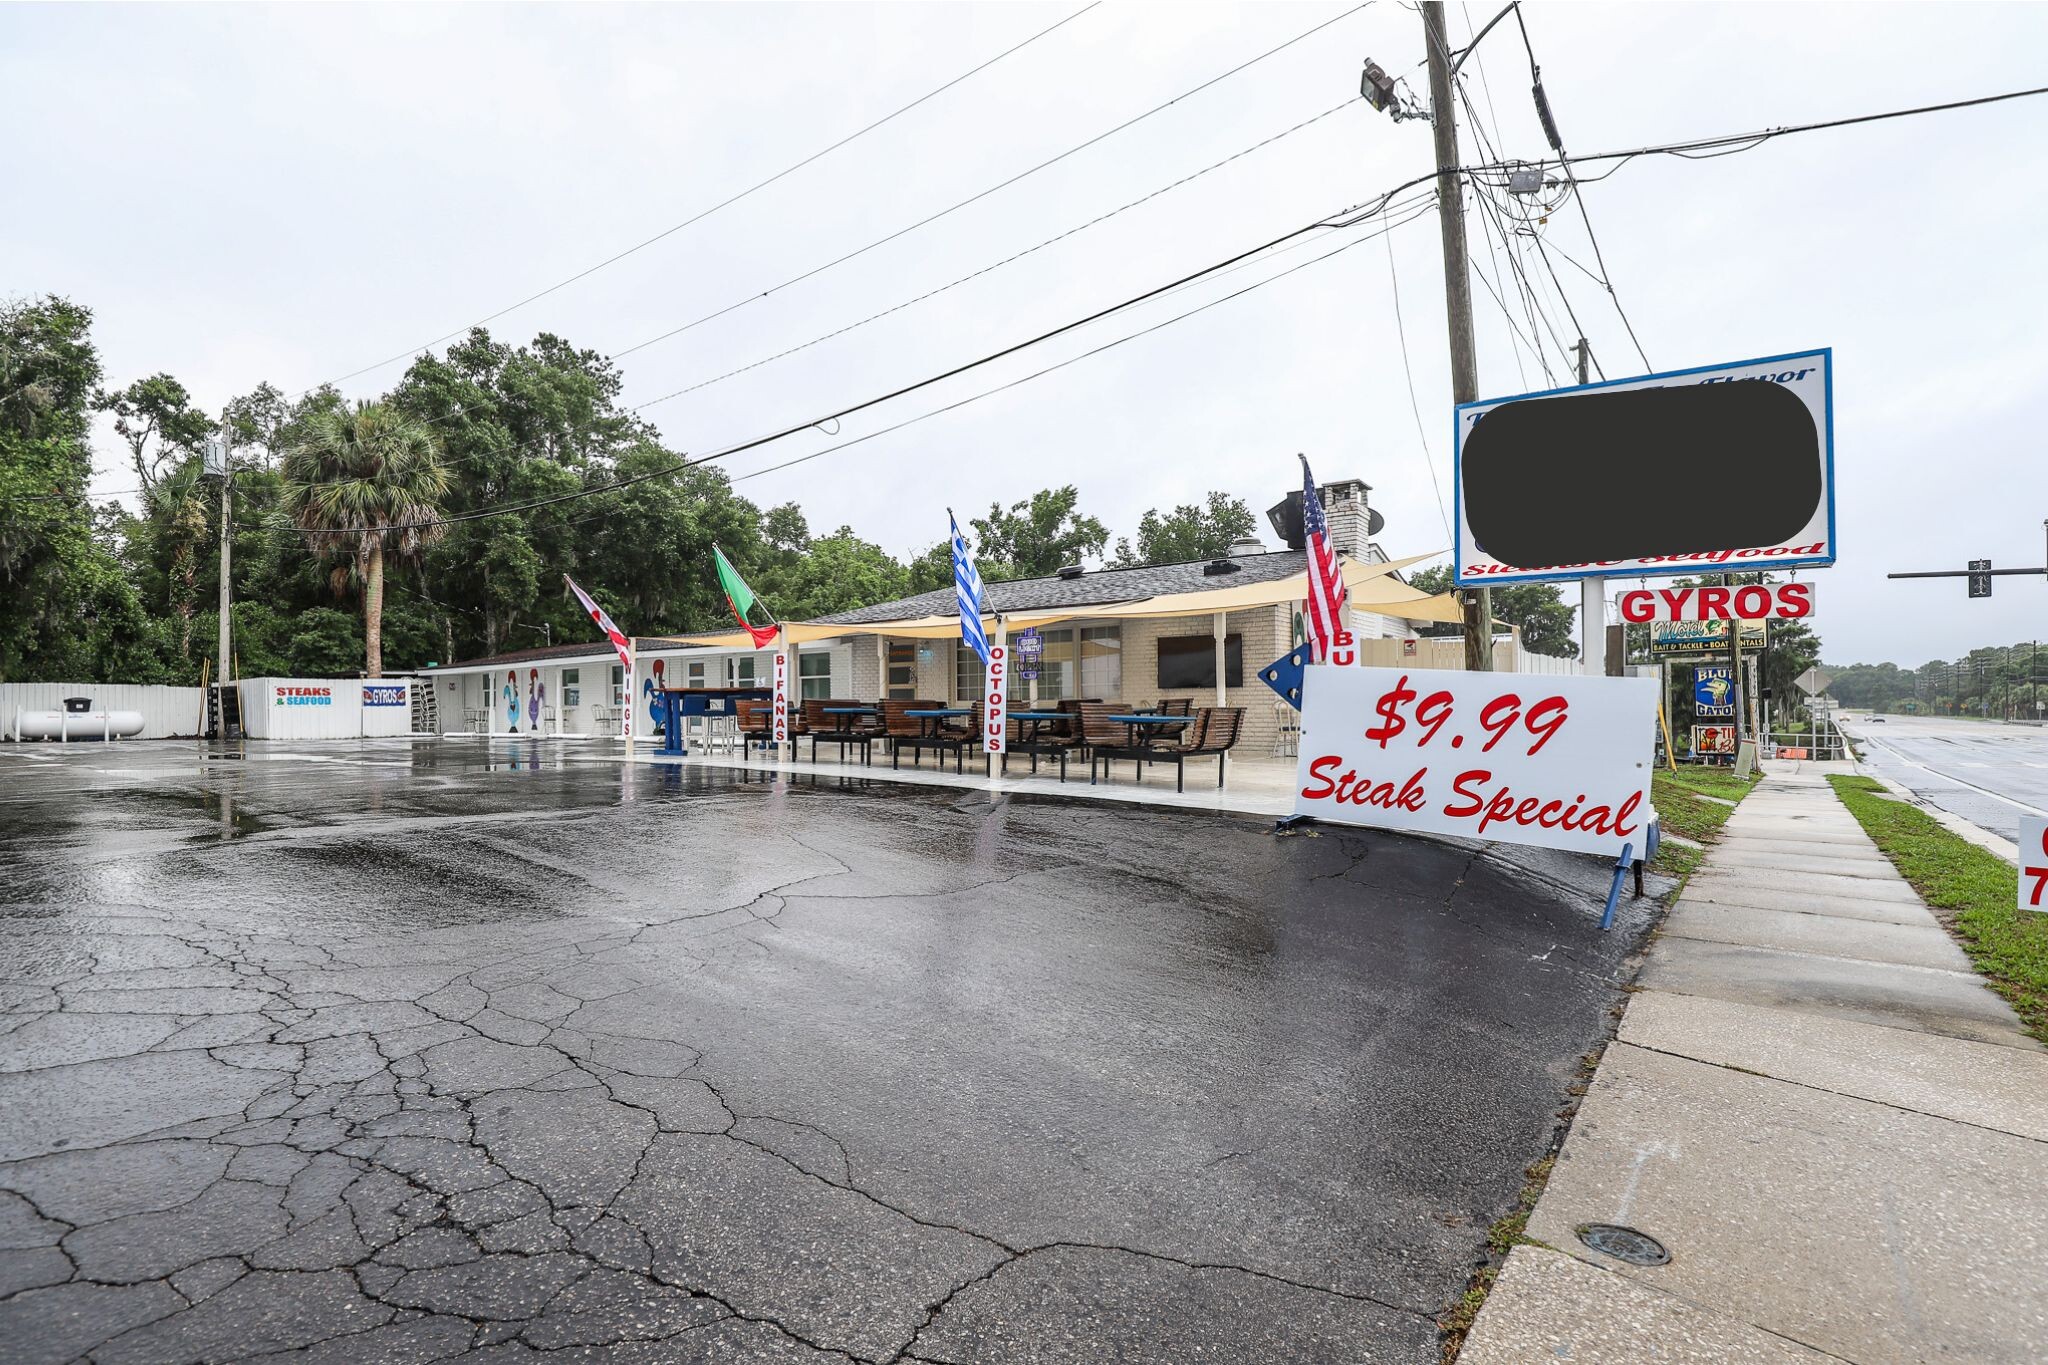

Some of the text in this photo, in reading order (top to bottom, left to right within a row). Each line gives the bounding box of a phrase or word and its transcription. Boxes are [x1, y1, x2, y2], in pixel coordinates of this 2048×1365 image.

[1621, 583, 1811, 623] GYROS
[1332, 631, 1354, 666] BU
[1653, 643, 1669, 651] BAIT
[1679, 641, 1703, 649] TACKLE
[1710, 640, 1729, 648] BOAT
[1740, 639, 1764, 647] NTALS
[276, 688, 331, 696] STEAKS
[286, 697, 331, 706] SEAFOOD
[373, 689, 398, 703] GYROS
[776, 655, 785, 741] BIFANAS
[988, 647, 1004, 751] OCTOPUS
[1365, 675, 1568, 756] $9.99
[1697, 704, 1733, 716] GATO
[1301, 755, 1643, 837] Steak Special
